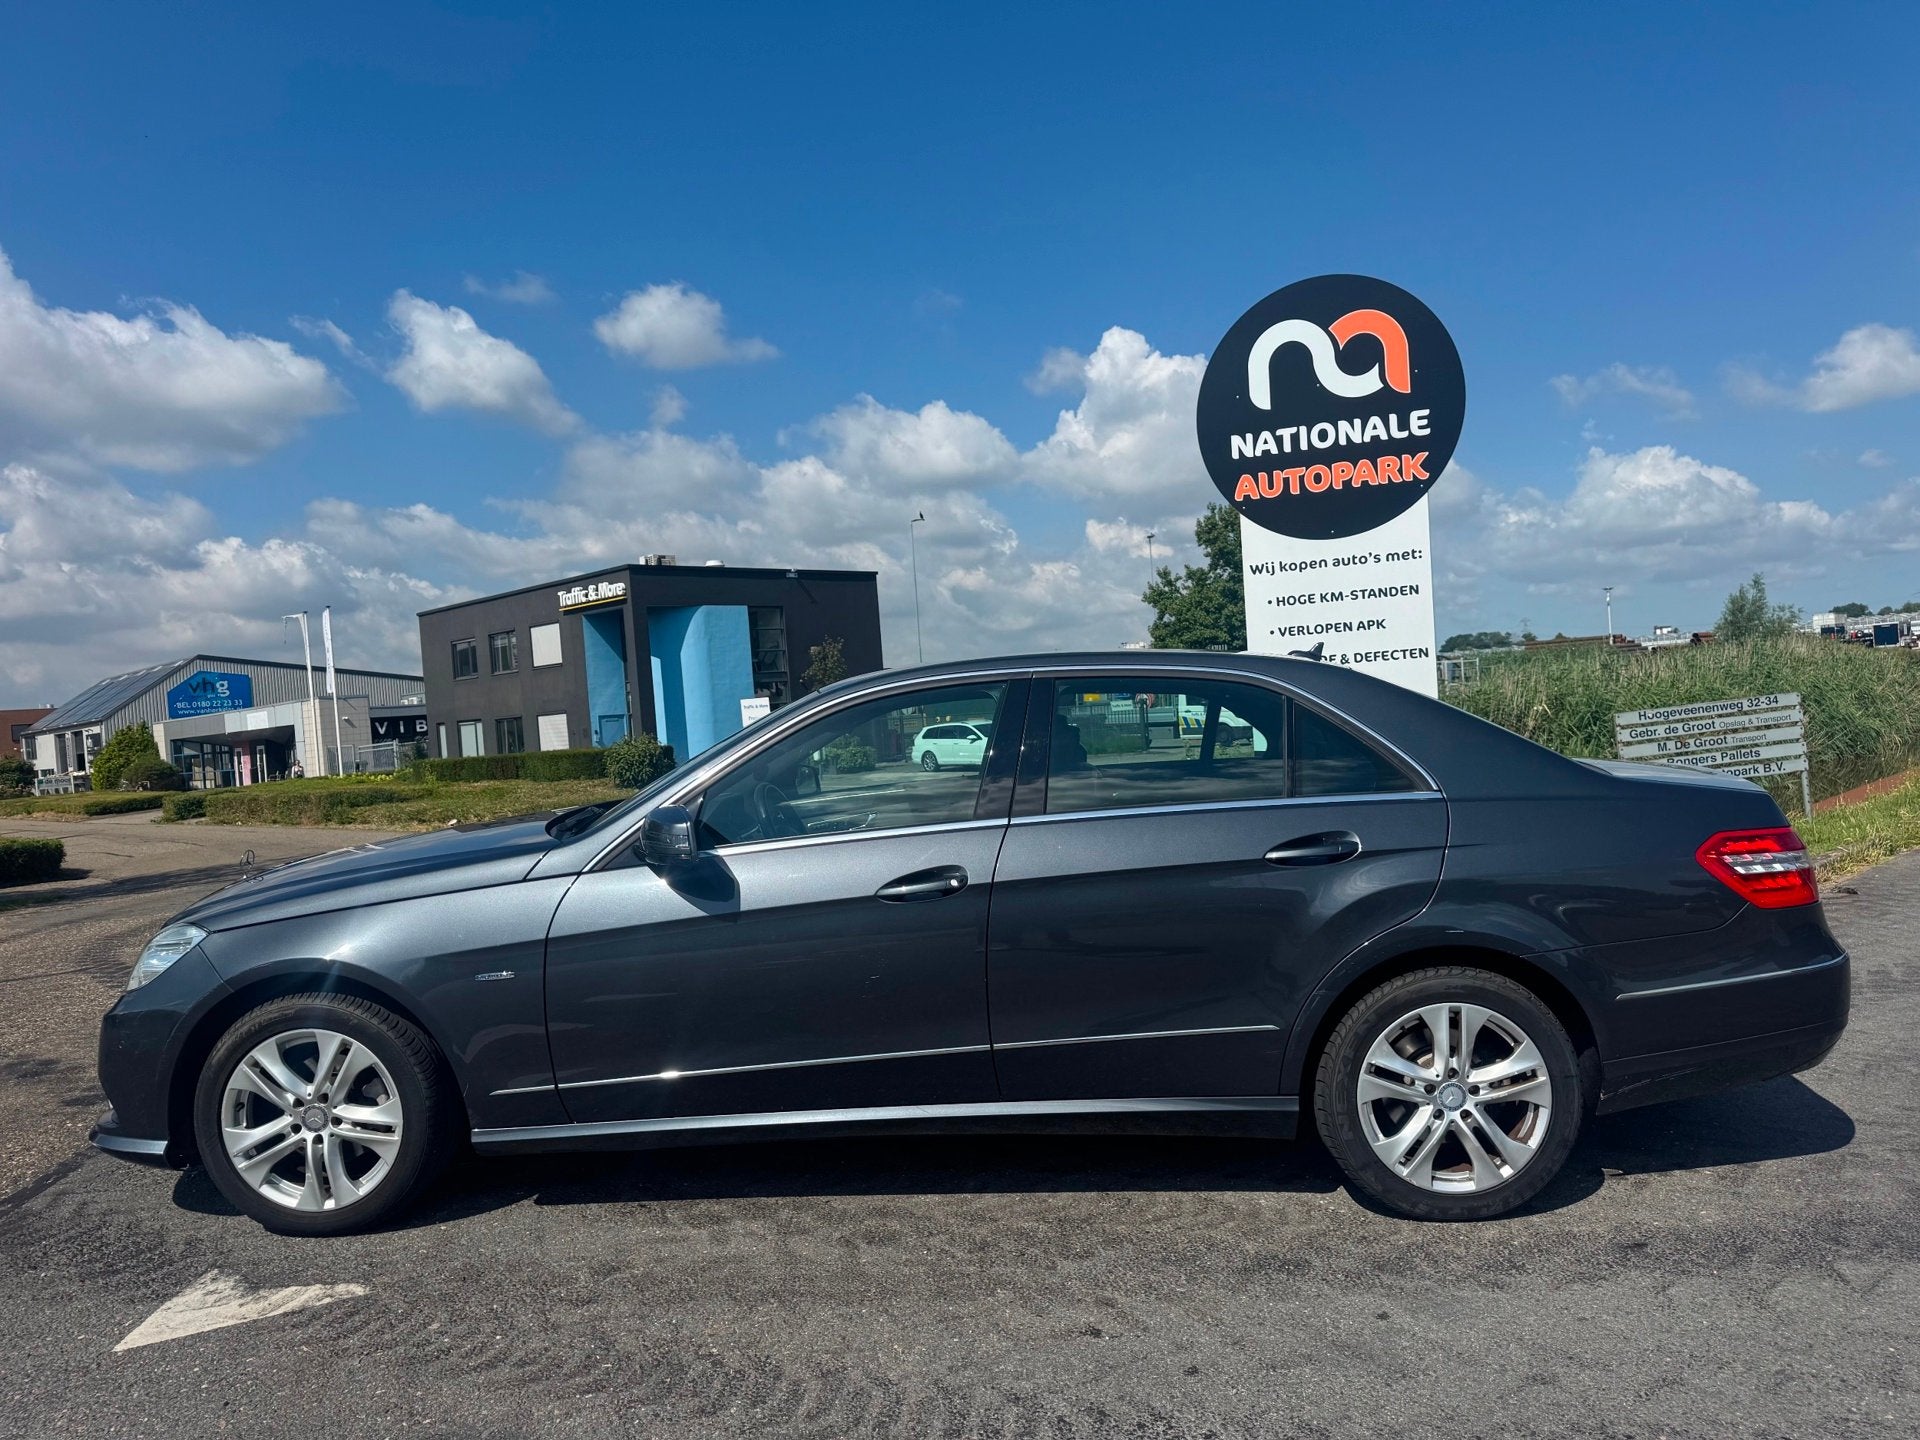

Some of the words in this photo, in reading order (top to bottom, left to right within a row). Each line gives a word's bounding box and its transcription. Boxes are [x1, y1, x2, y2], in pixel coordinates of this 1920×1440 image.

[1230, 409, 1431, 459] NATIONALE
[1234, 452, 1430, 501] AUTOPARK
[1249, 562, 1275, 576] Wij
[1279, 557, 1328, 573] kopen
[1332, 552, 1381, 567] auto's
[1385, 548, 1423, 563] met:
[557, 586, 589, 607] Traffic
[588, 584, 598, 601] &
[598, 581, 626, 599] More
[1276, 593, 1316, 607] HOGE
[1320, 584, 1419, 603] KM-STANDEN
[1278, 622, 1353, 637] VERLOPEN
[1356, 618, 1387, 631] APK
[1340, 653, 1350, 665] &
[1354, 647, 1429, 664] DEFECTEN
[188, 677, 230, 697] vhg
[192, 700, 211, 708] 0180
[1638, 701, 1744, 721] Hoogeveenenweg
[1747, 695, 1779, 708] 32-34
[1629, 727, 1660, 739] Gebr.
[1664, 725, 1679, 735] de
[1682, 720, 1716, 733] Groot
[1719, 719, 1746, 729] Opslag
[1748, 718, 1754, 726] &
[1756, 713, 1792, 724] Transport
[1657, 741, 1671, 752] M.
[1675, 740, 1690, 750] De
[1694, 735, 1728, 748] Groot
[1731, 733, 1767, 743] Transport
[1721, 749, 1761, 761] Pallets
[1763, 761, 1786, 773] B.V.
